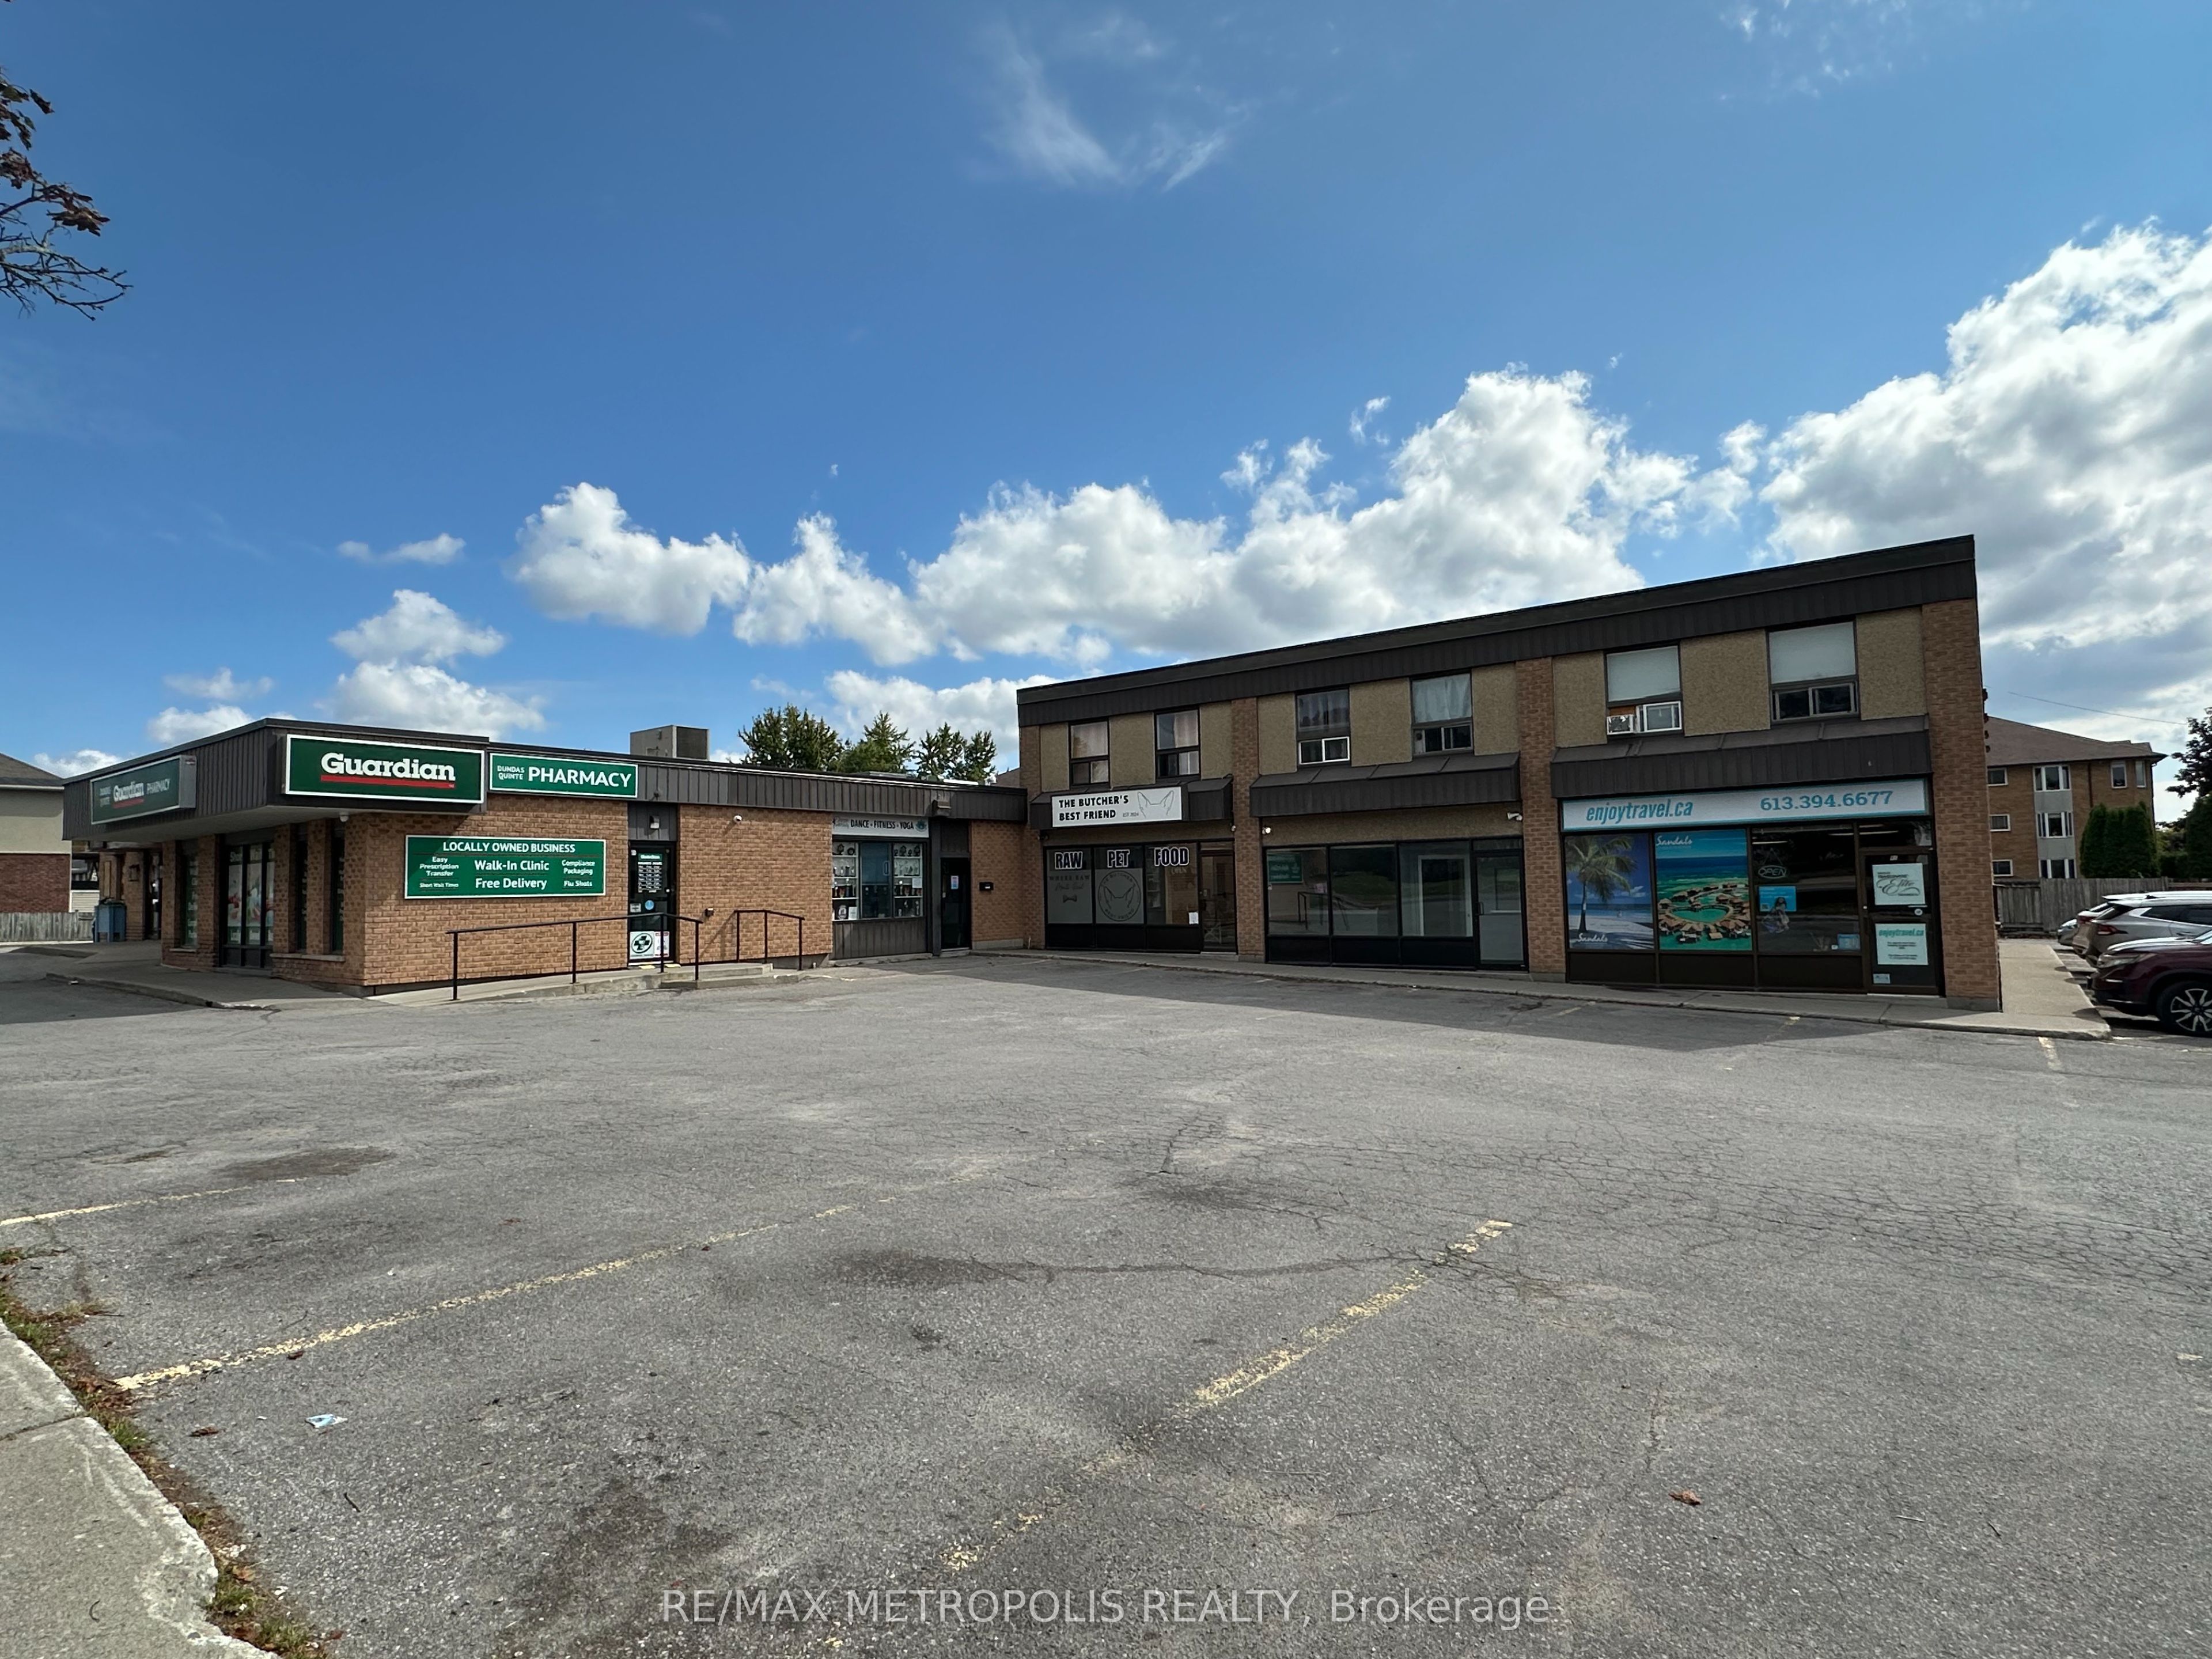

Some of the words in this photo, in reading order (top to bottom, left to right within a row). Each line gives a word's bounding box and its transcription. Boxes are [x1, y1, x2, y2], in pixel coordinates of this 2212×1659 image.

[321, 752, 456, 781] Guardian
[497, 765, 525, 773] DUNDAS
[528, 766, 632, 787] PHARMACY
[113, 781, 144, 802] Guardian
[1059, 800, 1075, 808] THE
[1078, 796, 1128, 806] BUTCHER'S
[1760, 790, 1893, 810] 613.394.6677
[1059, 812, 1080, 821] BEST
[1084, 810, 1116, 819] FRIEND
[1586, 799, 1694, 824] enjoytravel.ca
[850, 819, 869, 828] DANCE
[874, 820, 895, 829] FITNESS
[900, 821, 914, 830] YOGA
[1656, 835, 1692, 846] Sandals
[443, 842, 490, 851] LOCALLY
[492, 843, 529, 853] OWNED
[531, 843, 575, 853] BUSINESS
[1055, 851, 1083, 869] RAW
[1107, 849, 1130, 868] PET
[1154, 847, 1189, 866] FOOD
[474, 859, 517, 870] Walk-In
[520, 860, 550, 870] Clinic
[1759, 868, 1786, 876] OPEN
[475, 878, 500, 888] Free
[503, 878, 547, 890] Delivery
[1577, 933, 1608, 942] Sandals
